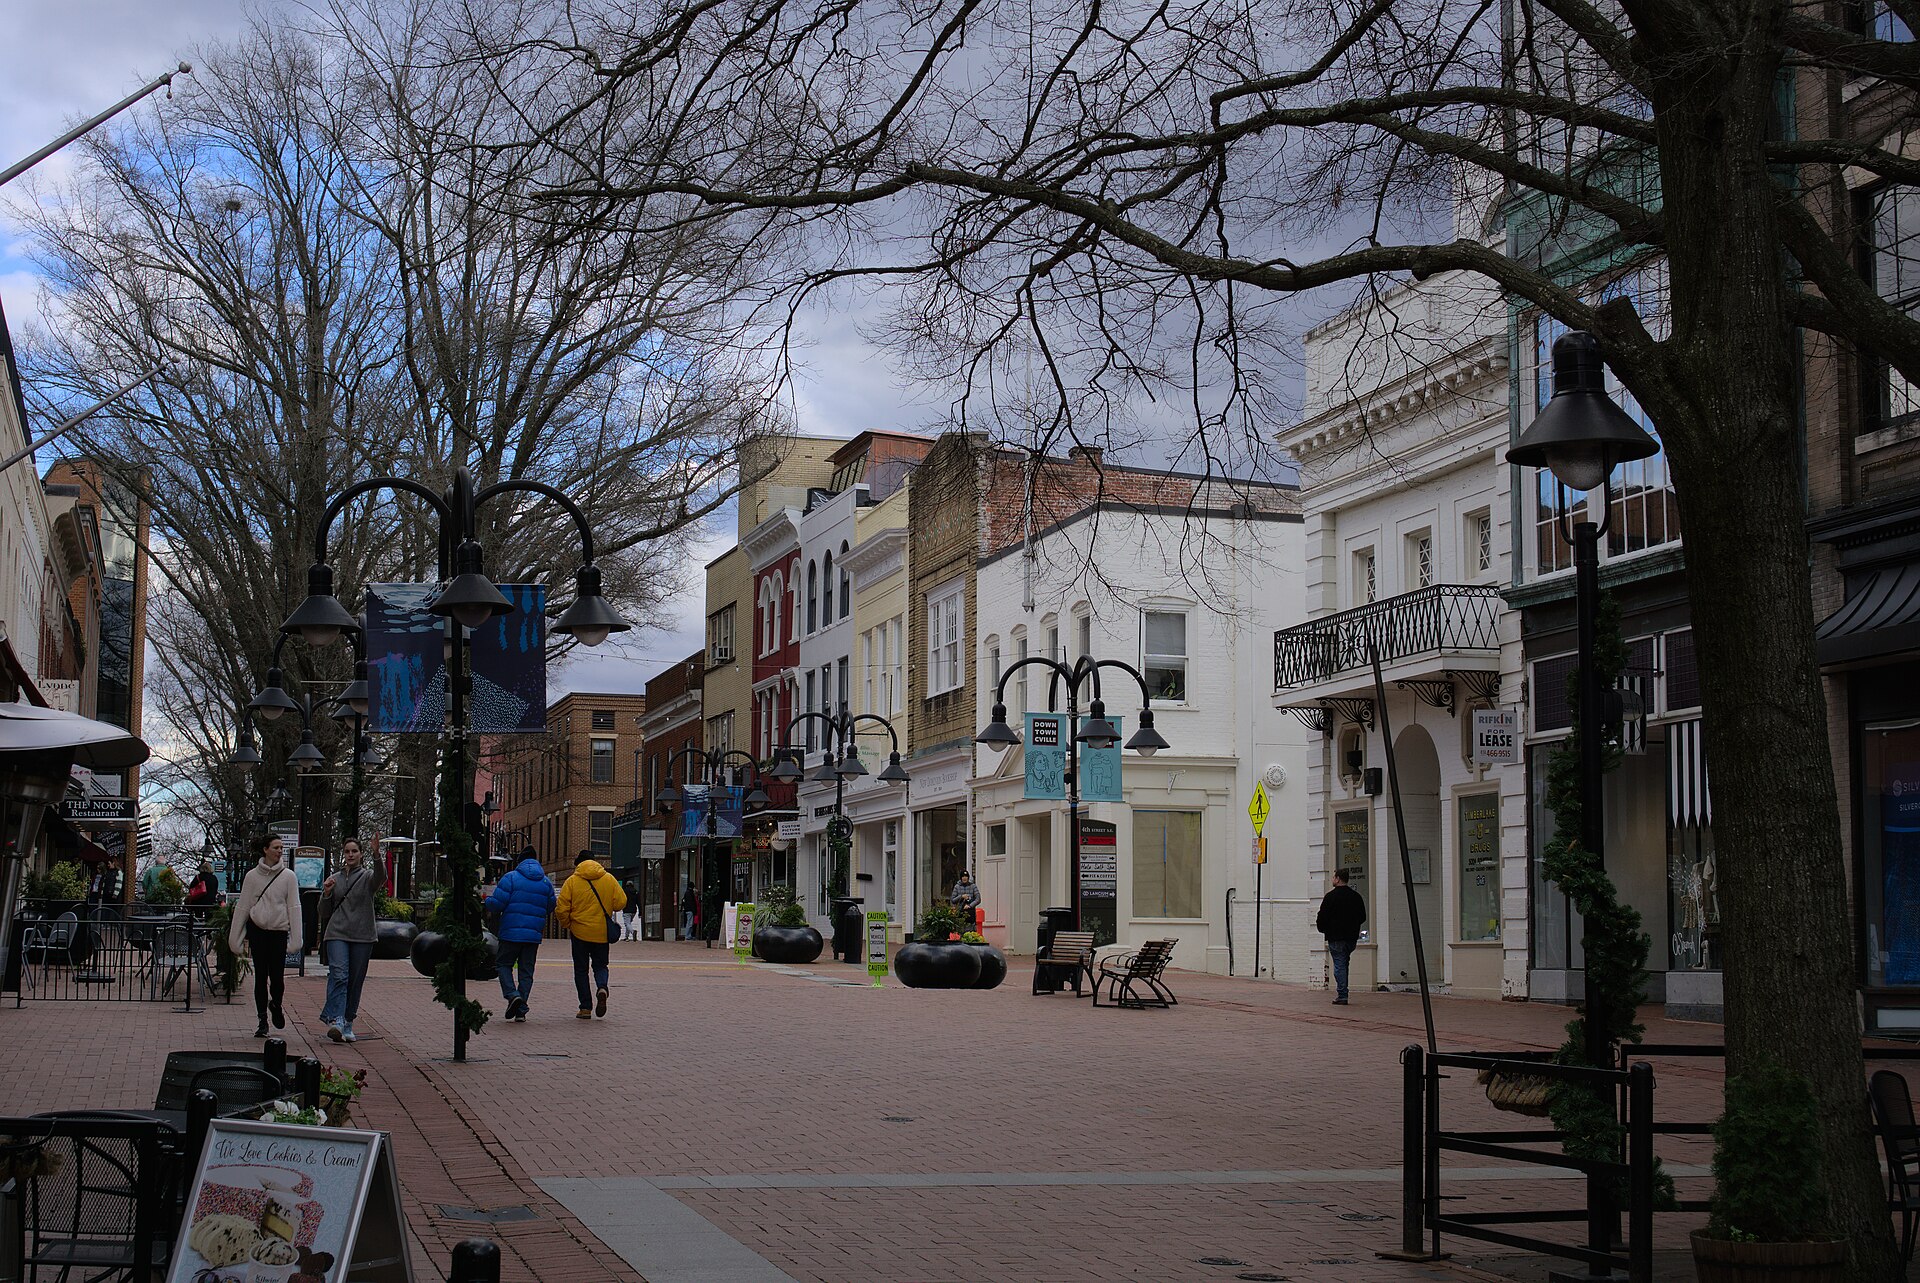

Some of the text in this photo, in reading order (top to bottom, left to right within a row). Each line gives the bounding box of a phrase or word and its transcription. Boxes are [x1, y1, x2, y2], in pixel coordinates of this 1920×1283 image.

[1478, 713, 1512, 724] RIFKIN
[1479, 733, 1512, 747] LEASE
[66, 801, 125, 810] THE NOOK
[71, 809, 119, 817] Restaurant
[1470, 843, 1491, 854] DRUGS
[867, 912, 887, 920] CAUTION
[868, 964, 888, 972] CAUTION
[215, 1138, 362, 1168] We Love Cookies & Cream!
